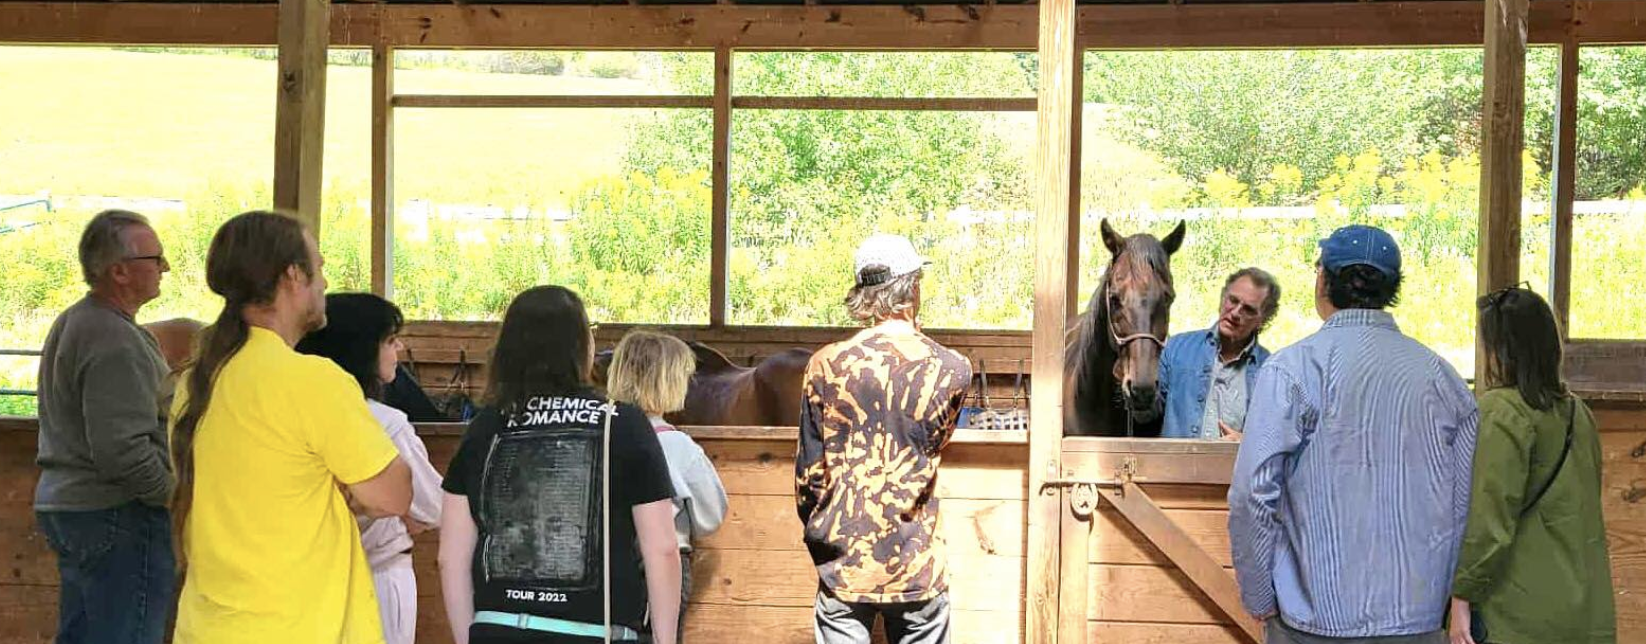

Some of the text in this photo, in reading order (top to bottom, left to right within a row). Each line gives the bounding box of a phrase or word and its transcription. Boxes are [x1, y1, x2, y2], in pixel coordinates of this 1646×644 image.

[526, 396, 619, 416] CHEMICAL
[505, 589, 568, 602] TOUR 2022
